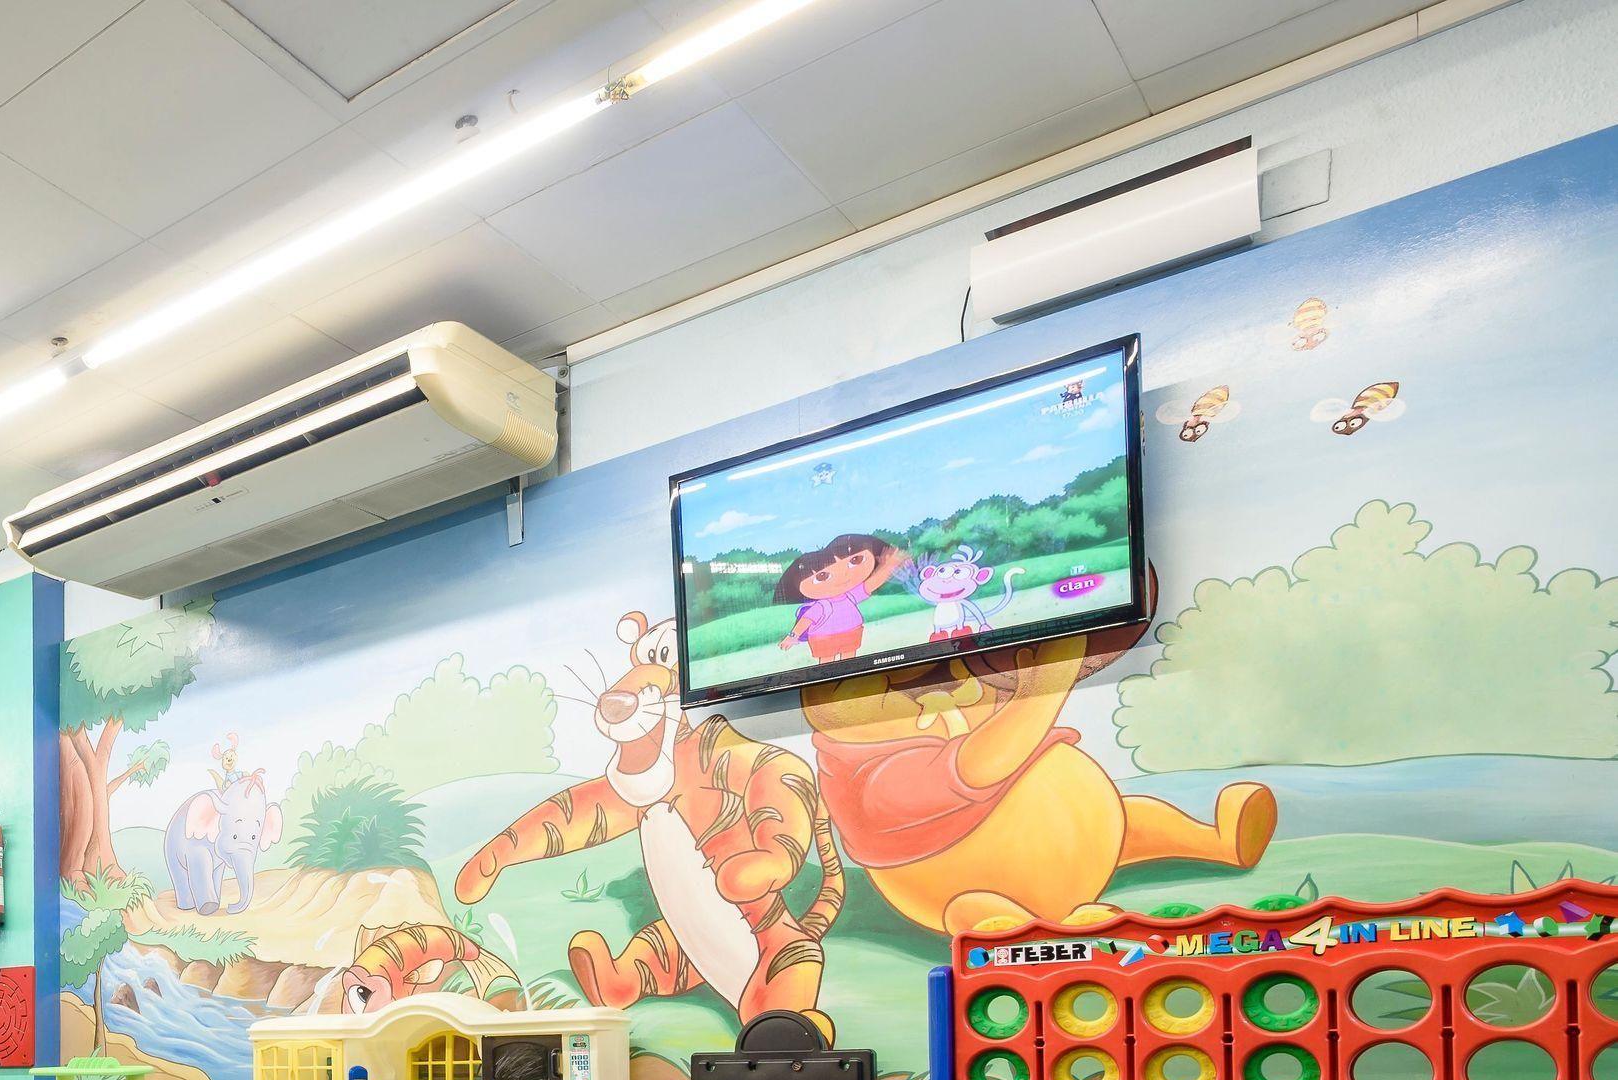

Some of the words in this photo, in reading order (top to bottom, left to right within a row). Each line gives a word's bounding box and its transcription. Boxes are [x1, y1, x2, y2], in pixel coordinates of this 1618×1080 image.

[1059, 579, 1094, 593] clan
[873, 654, 905, 665] SAMSUNG
[1176, 928, 1286, 957] MEGA
[1289, 916, 1338, 955] 4
[1339, 923, 1377, 943] IN
[1389, 917, 1479, 942] LINE
[1011, 943, 1087, 963] FEBER
